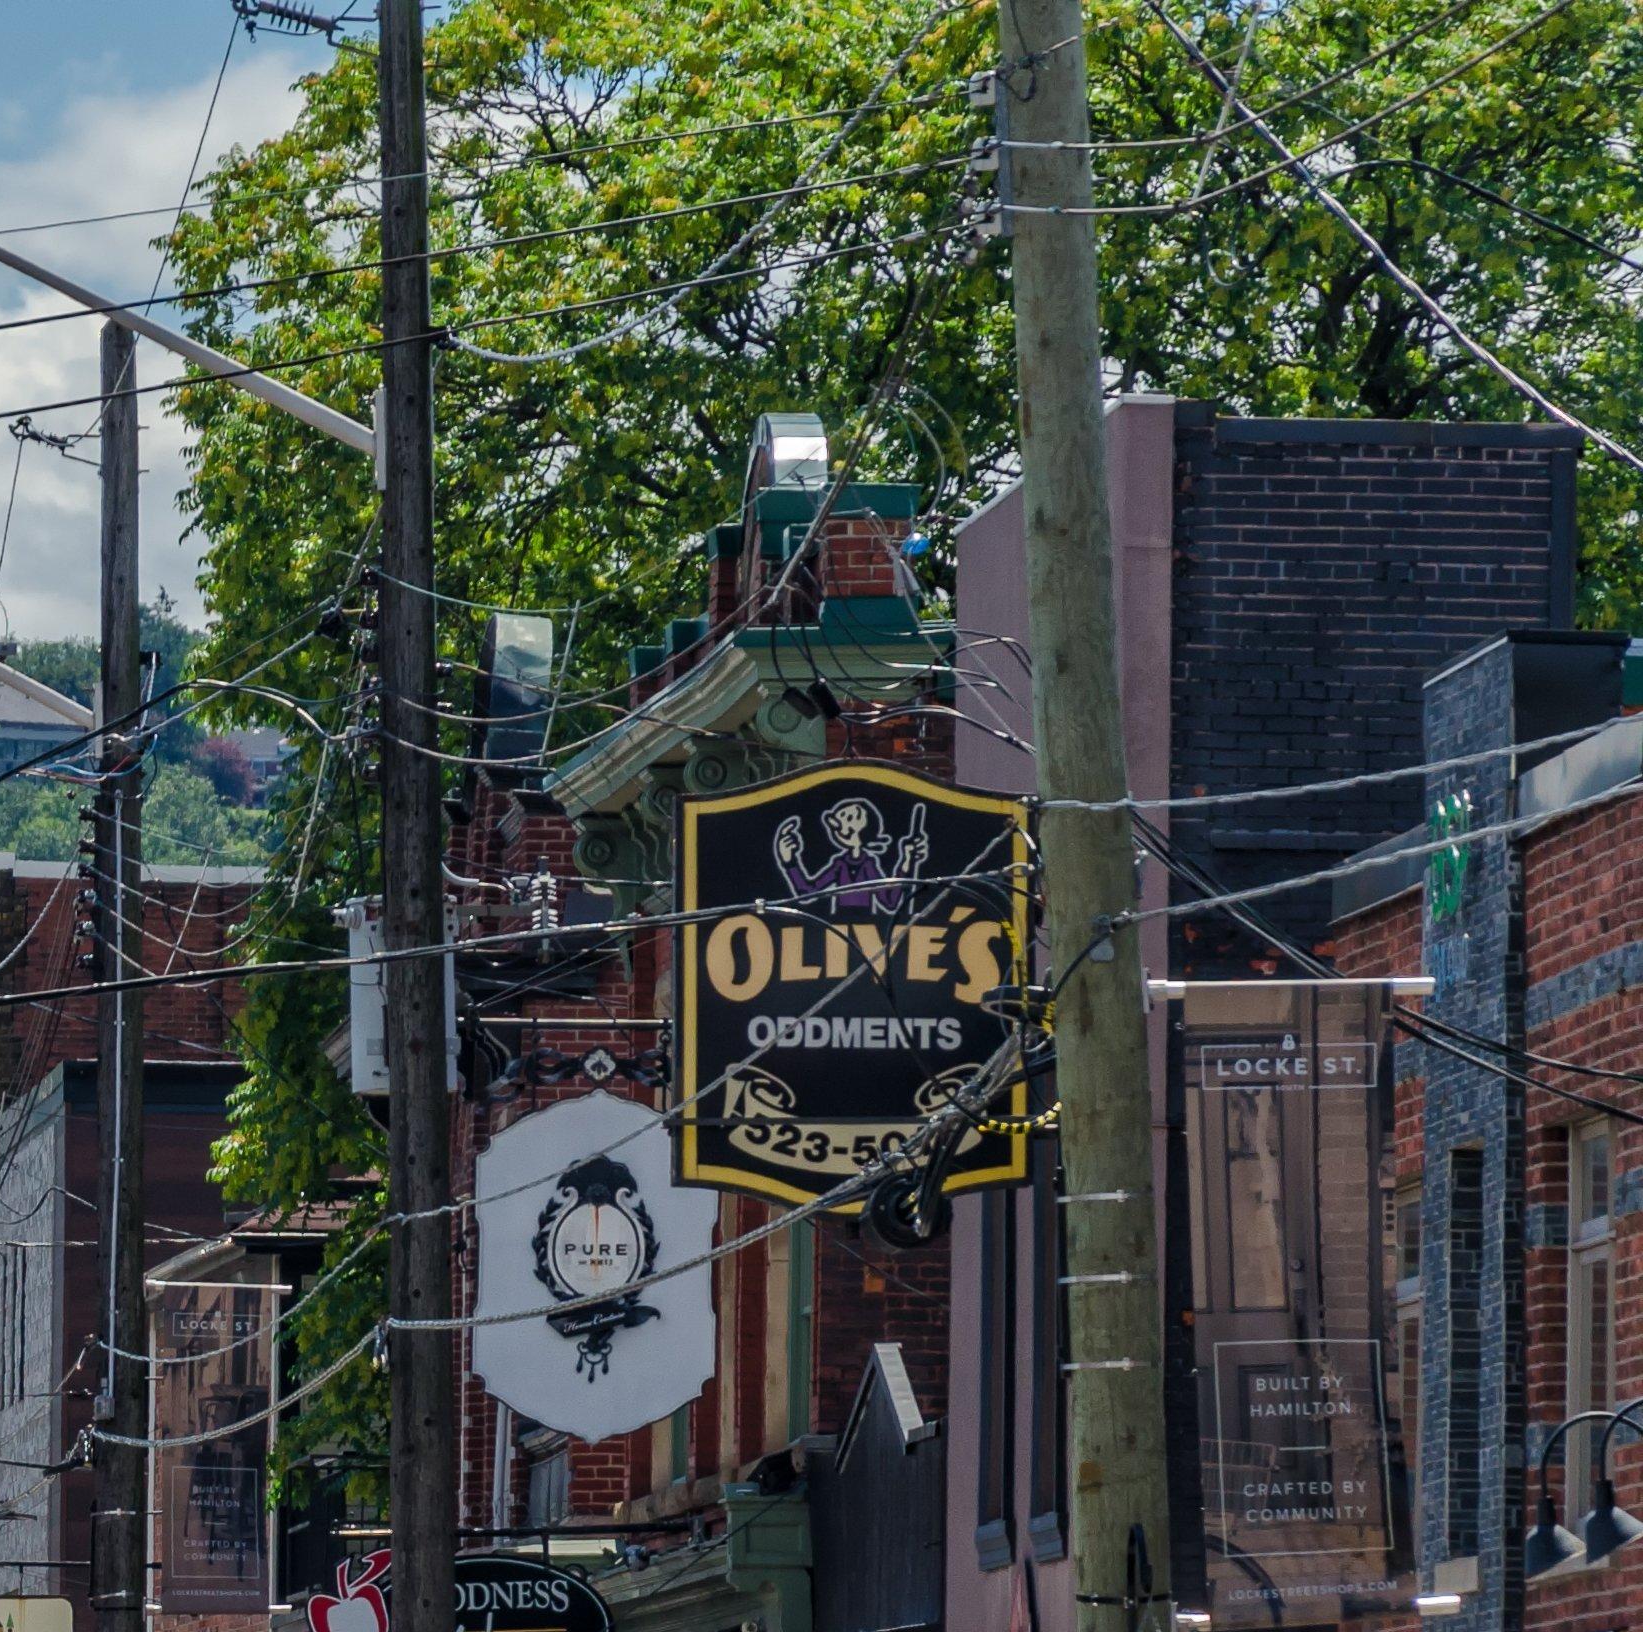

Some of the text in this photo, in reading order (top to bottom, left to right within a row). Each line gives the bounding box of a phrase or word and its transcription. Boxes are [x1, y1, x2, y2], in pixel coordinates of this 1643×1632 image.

[706, 906, 1004, 1004] OLIVE'S
[747, 1015, 963, 1051] ODDMENTS
[1216, 1055, 1361, 1077] LOCKE ST.
[564, 1243, 628, 1256] PURE
[1255, 1375, 1344, 1393] BUILT BY
[1249, 1401, 1352, 1418] HAMILTON
[1242, 1480, 1367, 1498] CRAFTED BY
[1245, 1506, 1368, 1523] COMMUNITY
[455, 1579, 570, 1612] DNESS
[1227, 1581, 1398, 1601] LOCKESTREETSHOPS.COM
